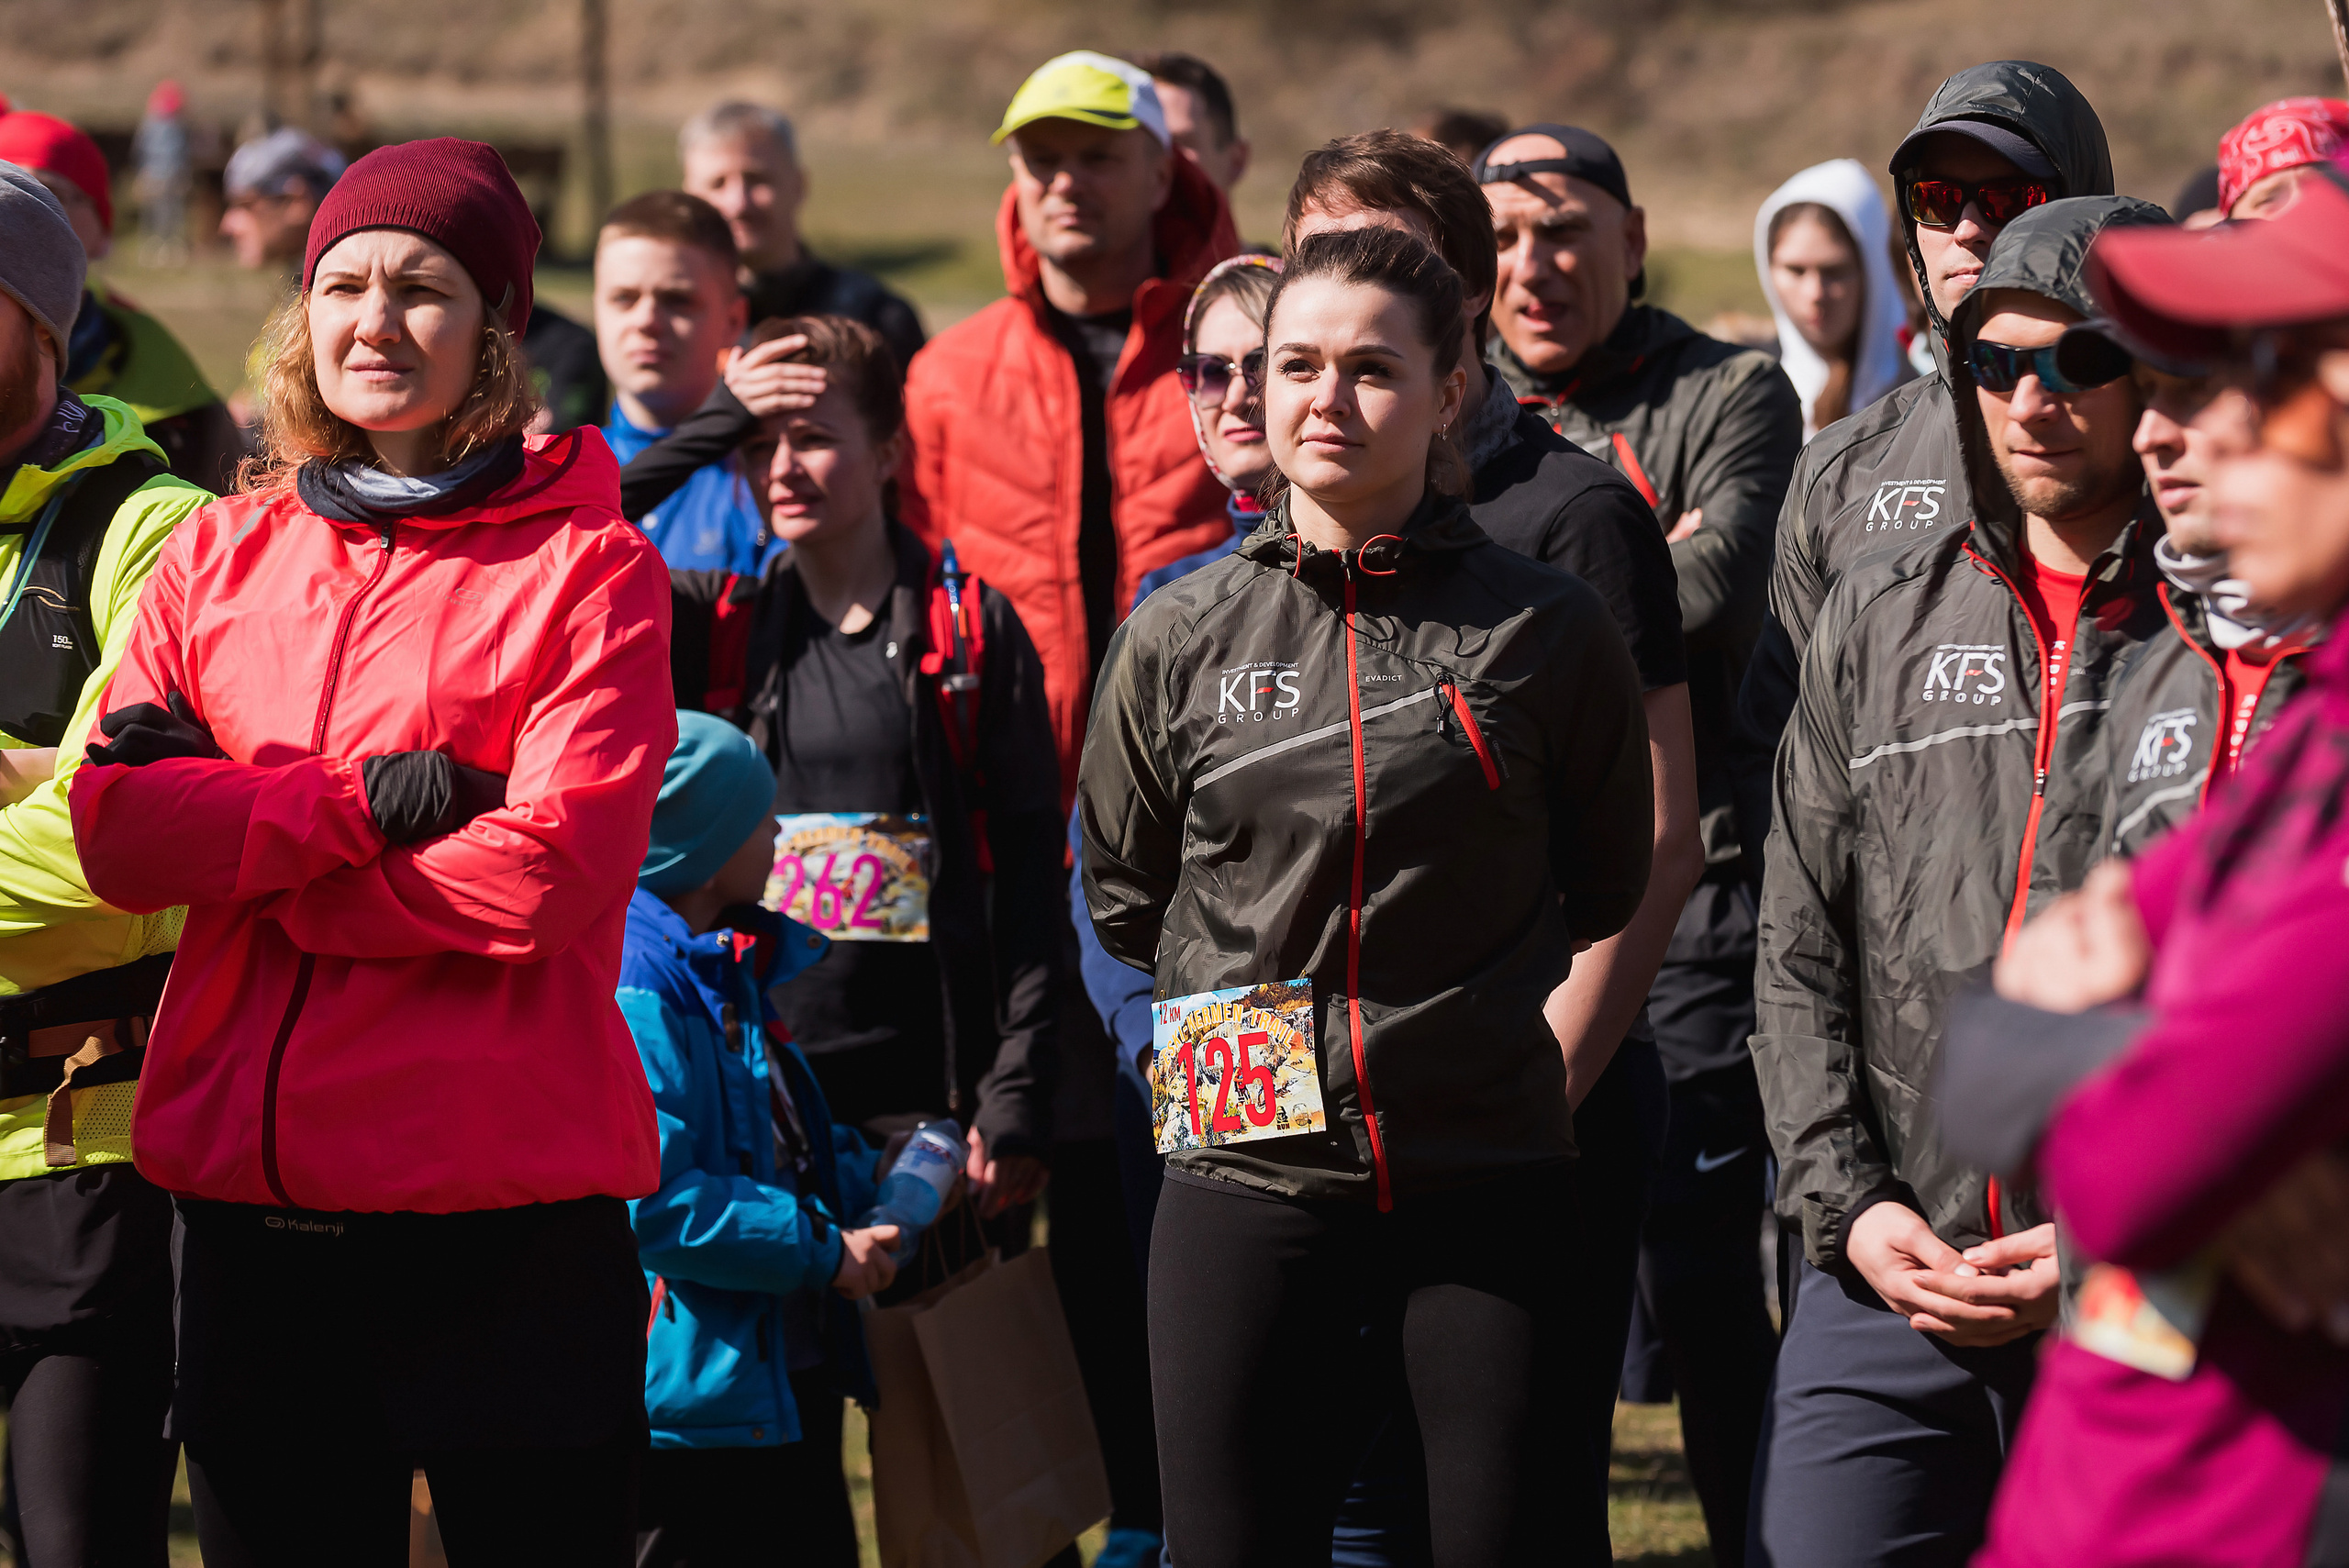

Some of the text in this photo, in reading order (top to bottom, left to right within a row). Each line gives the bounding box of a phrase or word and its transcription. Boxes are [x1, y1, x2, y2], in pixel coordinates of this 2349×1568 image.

[1867, 486, 1945, 521] KFS
[1865, 520, 1934, 531] GROUP
[1365, 674, 1402, 683] EVADICT
[1924, 652, 2006, 695] KFS
[1219, 670, 1301, 713] KFS
[1922, 690, 2001, 706] GROUP
[1218, 707, 1299, 724] GROUP
[772, 853, 884, 930] 262
[1159, 1003, 1181, 1026] 12 KM
[1163, 1004, 1295, 1066] ESKI-KERMEN TRAIL
[1178, 1031, 1277, 1136] 125
[1276, 1122, 1290, 1130] RUN
[287, 1218, 344, 1237] Kalenji
